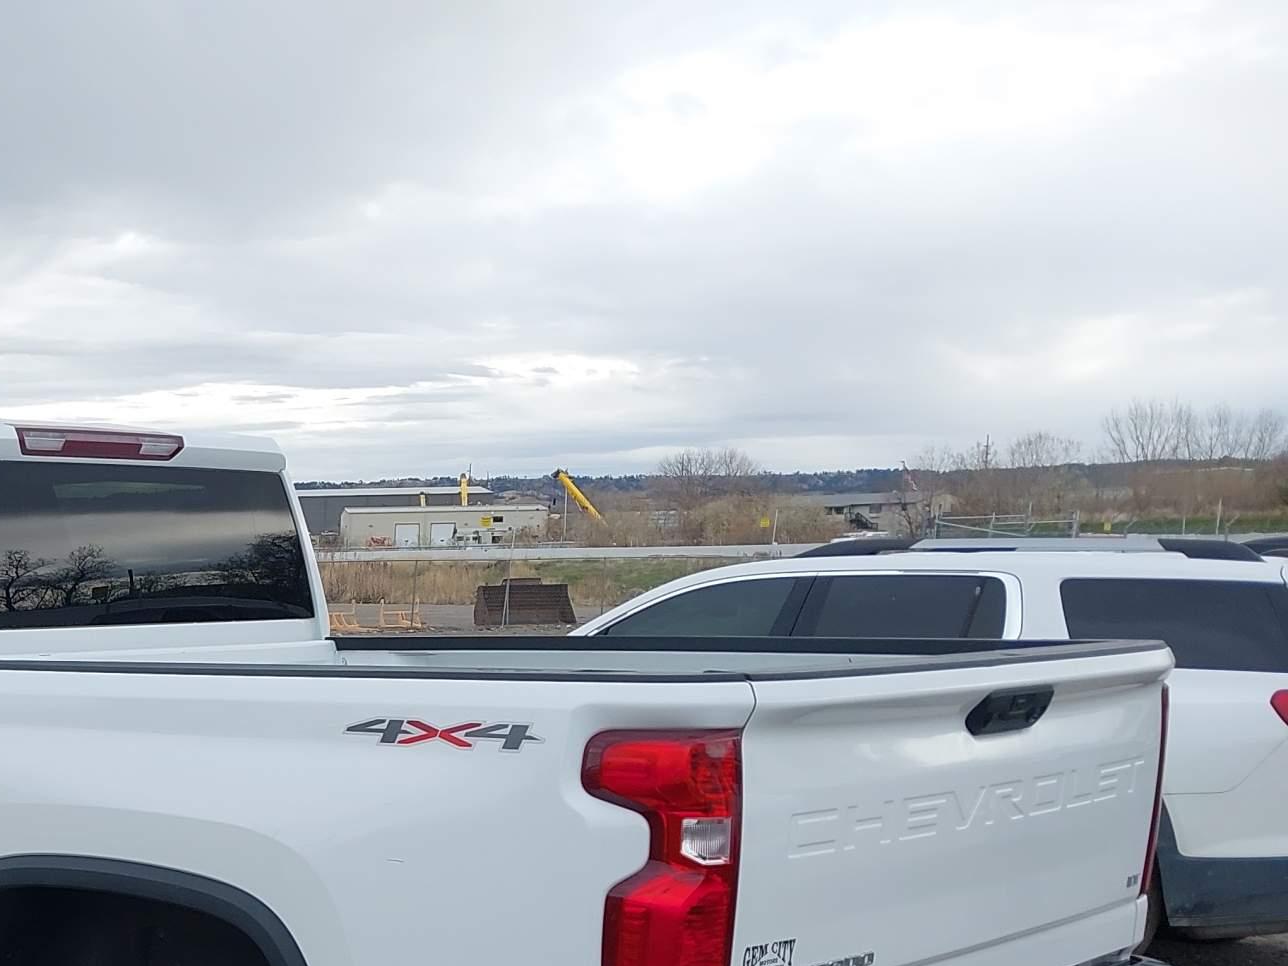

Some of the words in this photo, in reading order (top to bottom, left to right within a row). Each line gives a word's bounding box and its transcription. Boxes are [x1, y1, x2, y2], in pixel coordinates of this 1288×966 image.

[787, 756, 1145, 859] CHEVROLET
[759, 957, 778, 966] MOTORS
[771, 938, 796, 966] CITY
